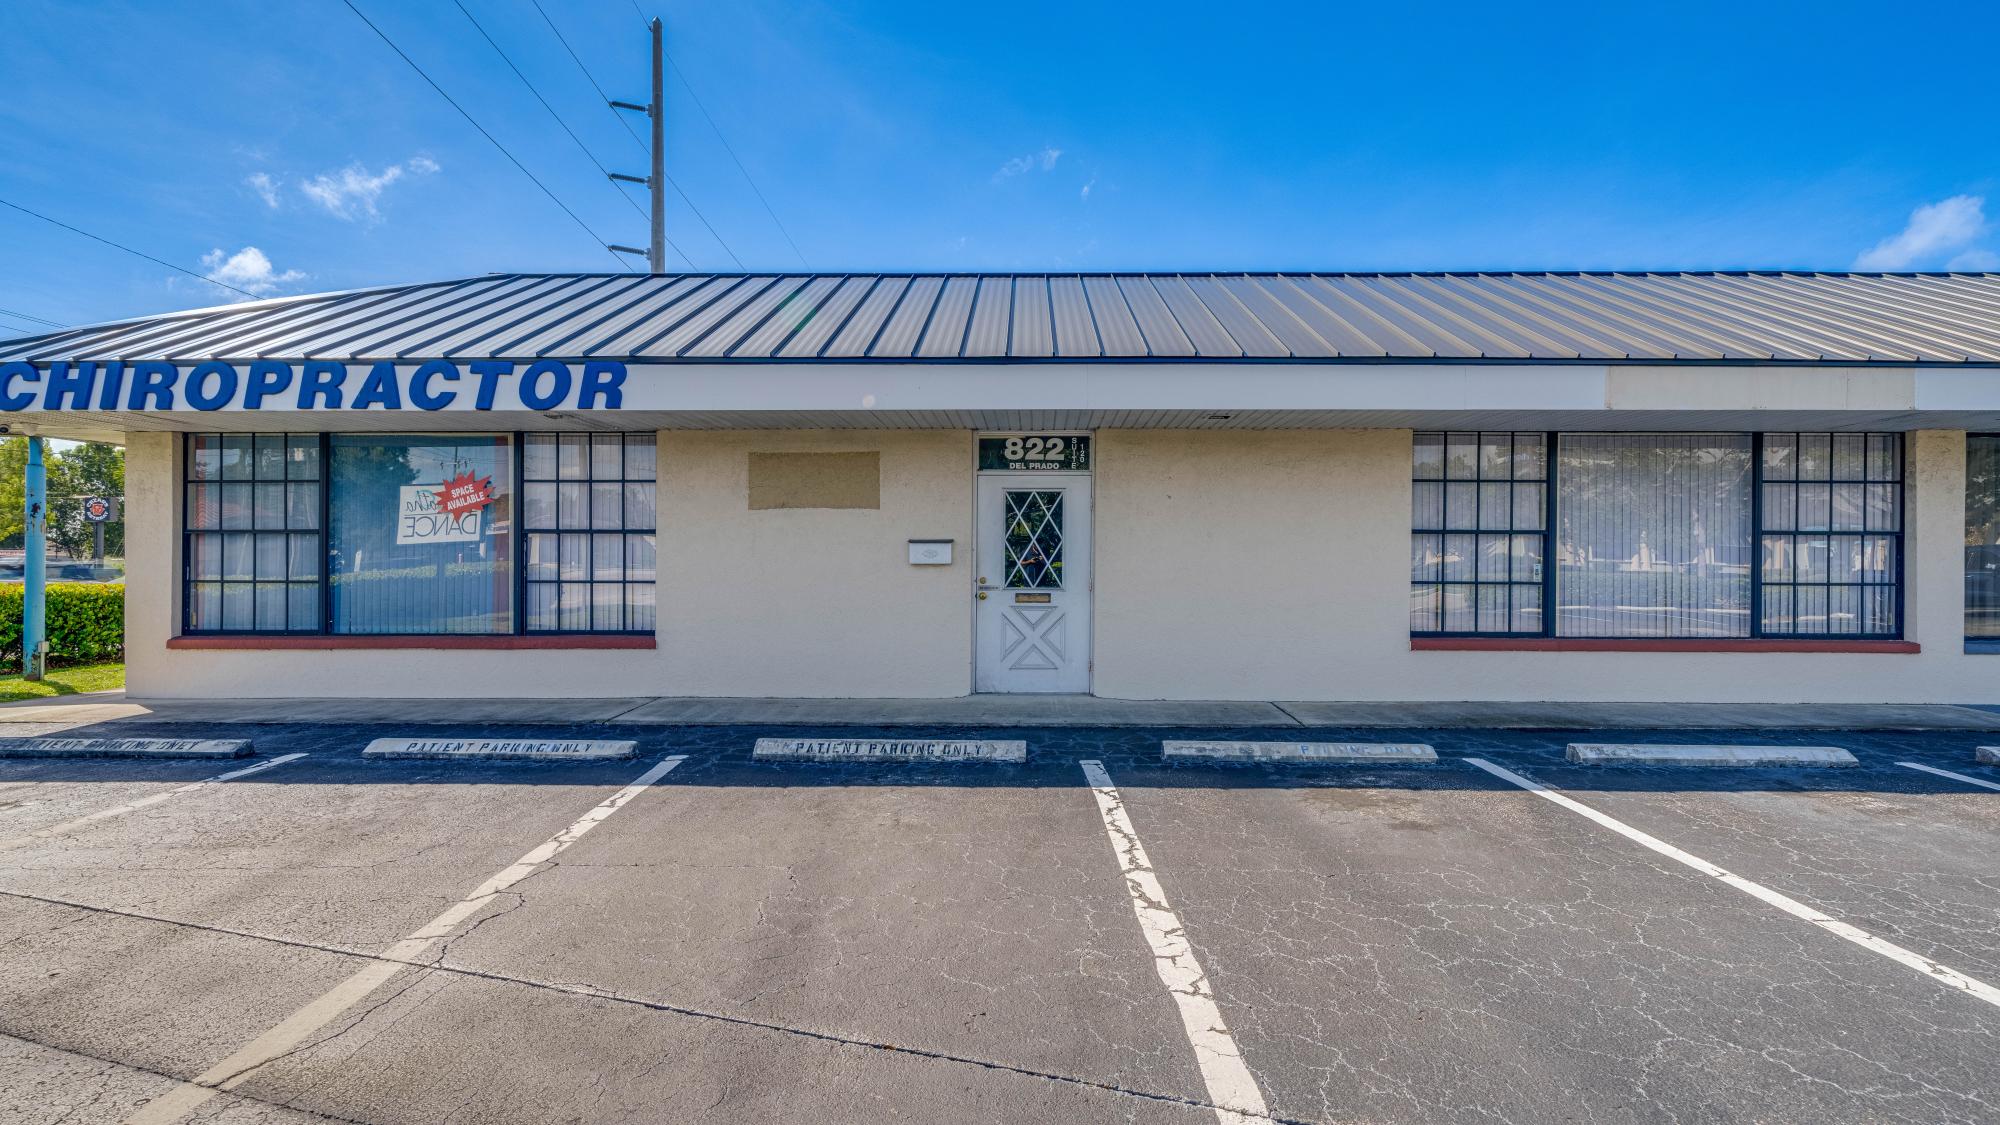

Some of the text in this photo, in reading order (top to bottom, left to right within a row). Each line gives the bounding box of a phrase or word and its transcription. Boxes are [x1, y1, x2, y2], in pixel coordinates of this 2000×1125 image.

[0, 360, 627, 411] CHIROPRACTOR
[1004, 437, 1064, 460] 822
[451, 484, 475, 498] SPACE
[447, 491, 485, 511] AVAILABLE
[406, 742, 475, 752] PATIENT
[795, 742, 982, 755] PATIENT PARKING ONLY
